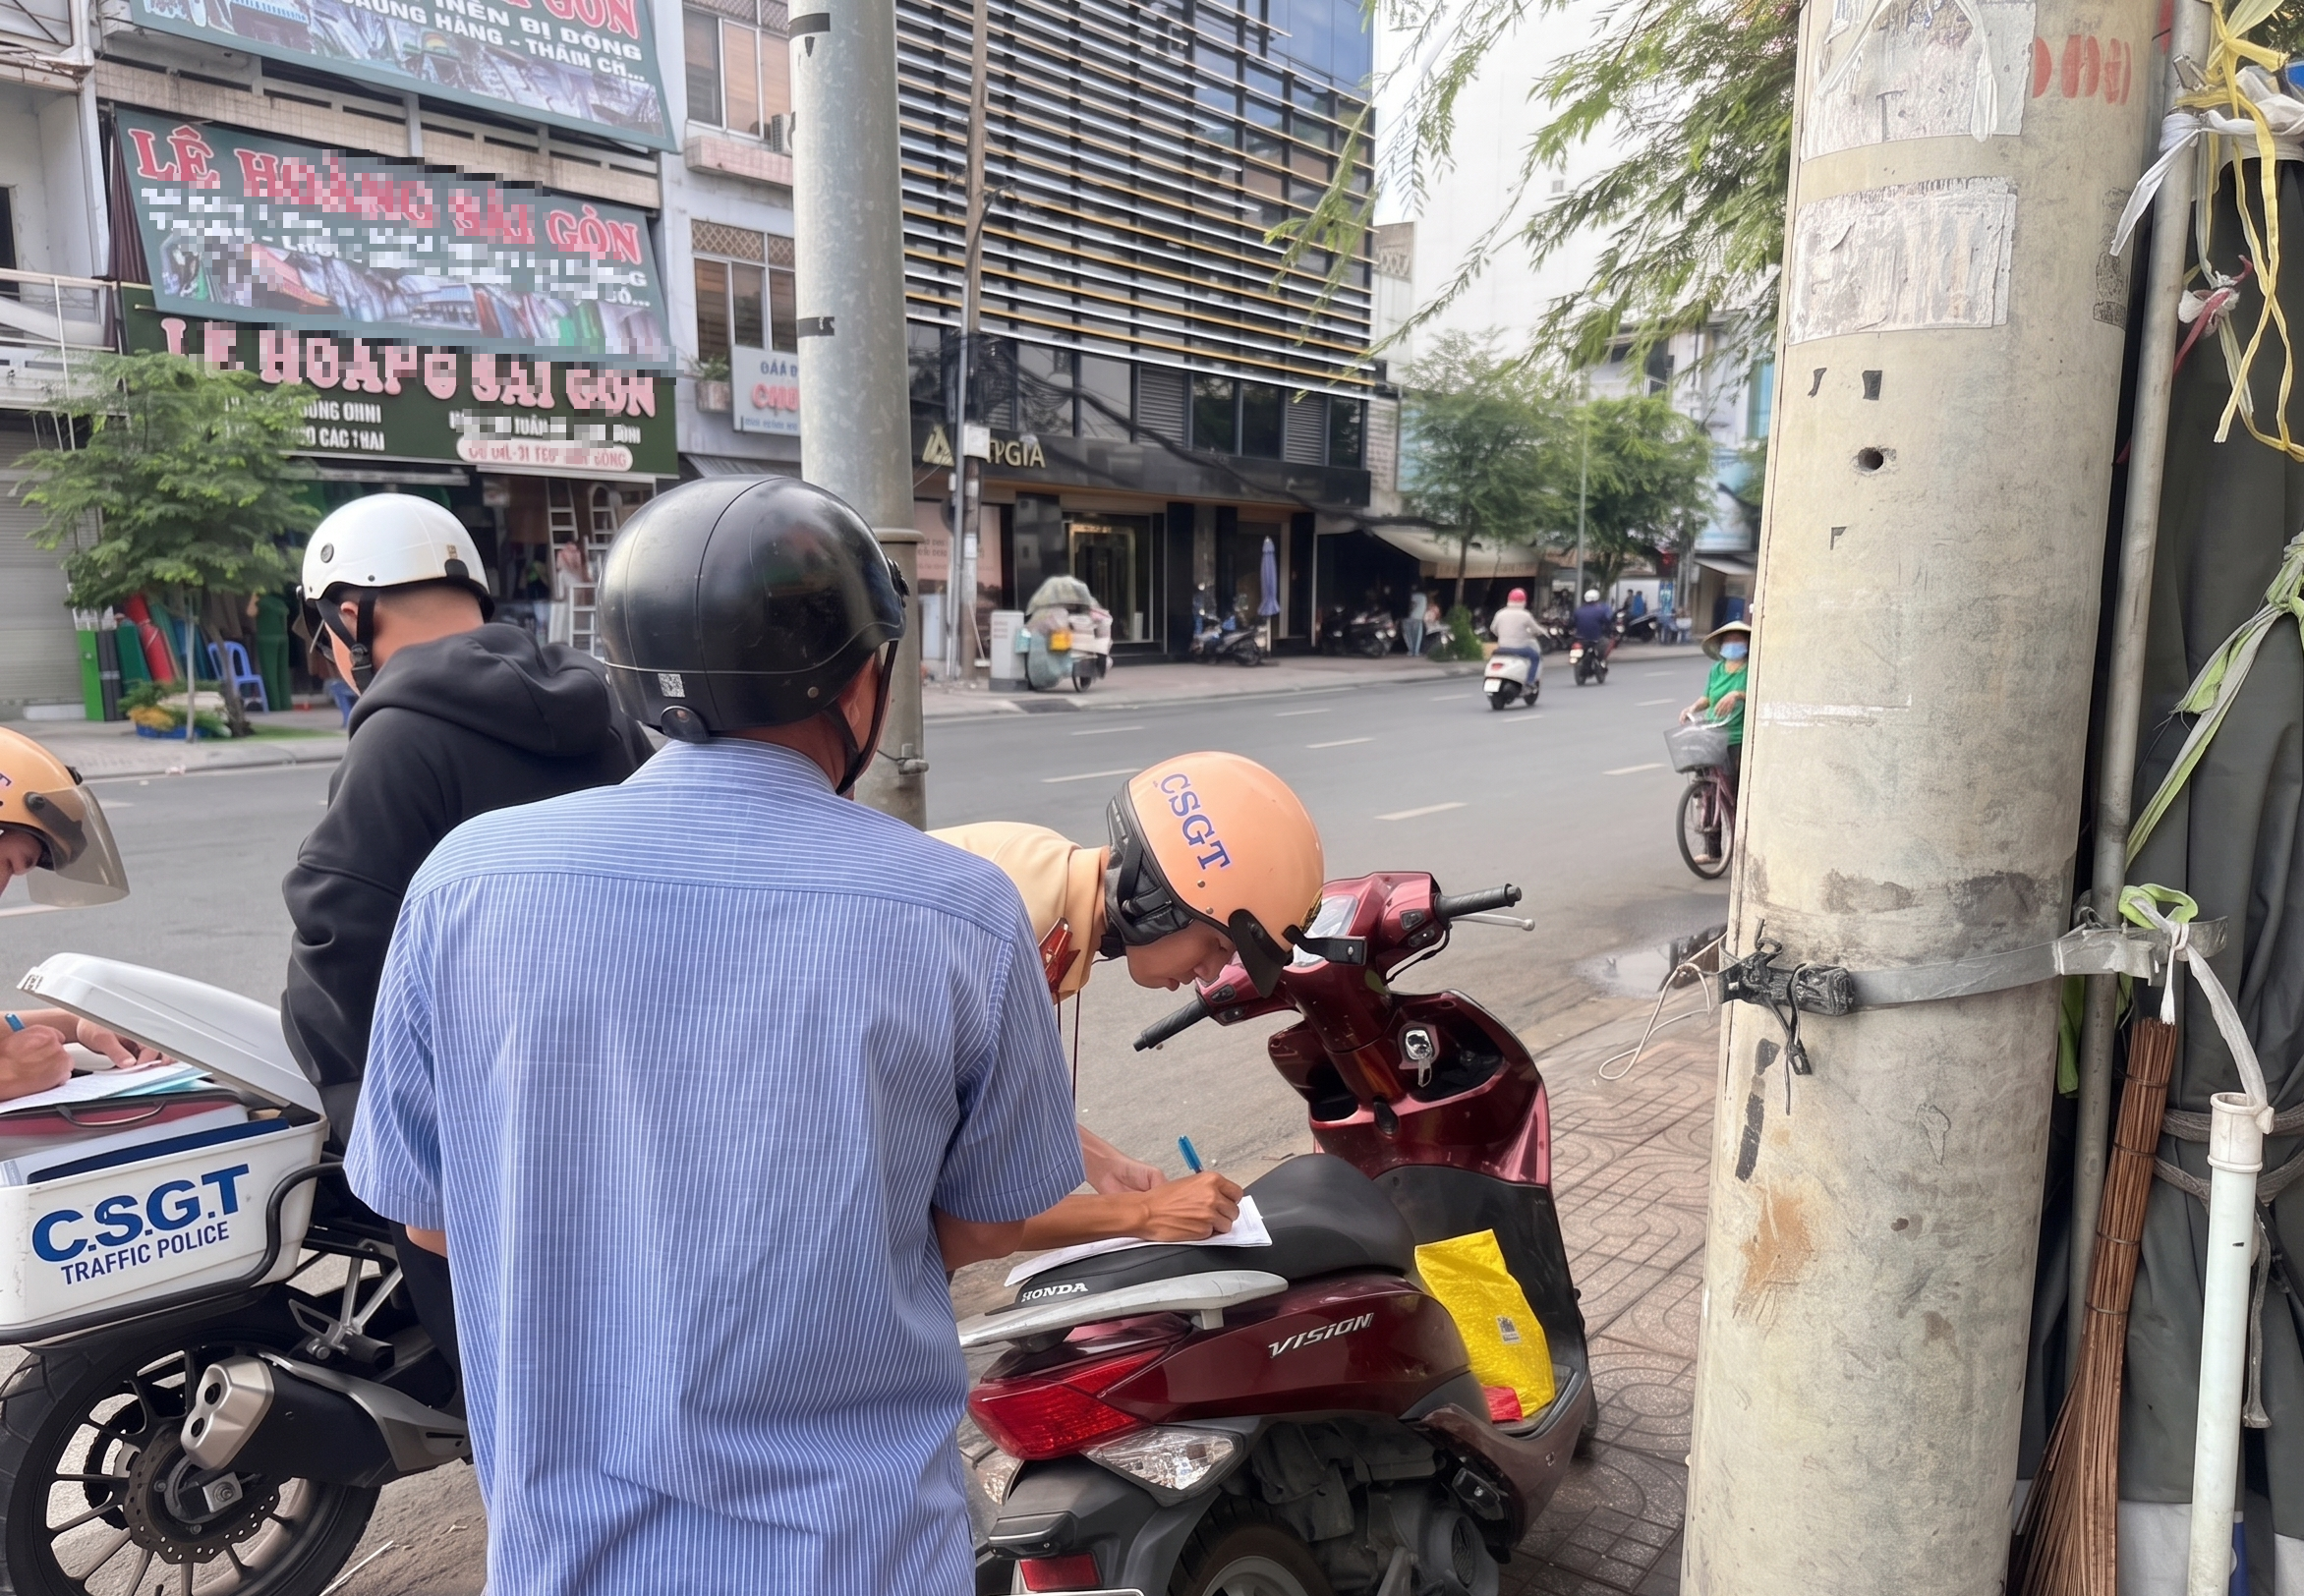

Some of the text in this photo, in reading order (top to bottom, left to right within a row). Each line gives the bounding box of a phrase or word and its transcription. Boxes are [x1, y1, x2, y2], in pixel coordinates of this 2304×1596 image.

[128, 125, 221, 188] LÊ
[545, 203, 643, 265] GÒN
[1161, 774, 1231, 871] CSGT
[32, 1164, 250, 1262] C.S.G.T
[61, 1221, 230, 1284] TRAFFIC POLICE
[1021, 1282, 1088, 1303] HONDA
[1268, 1312, 1374, 1359] VISION
